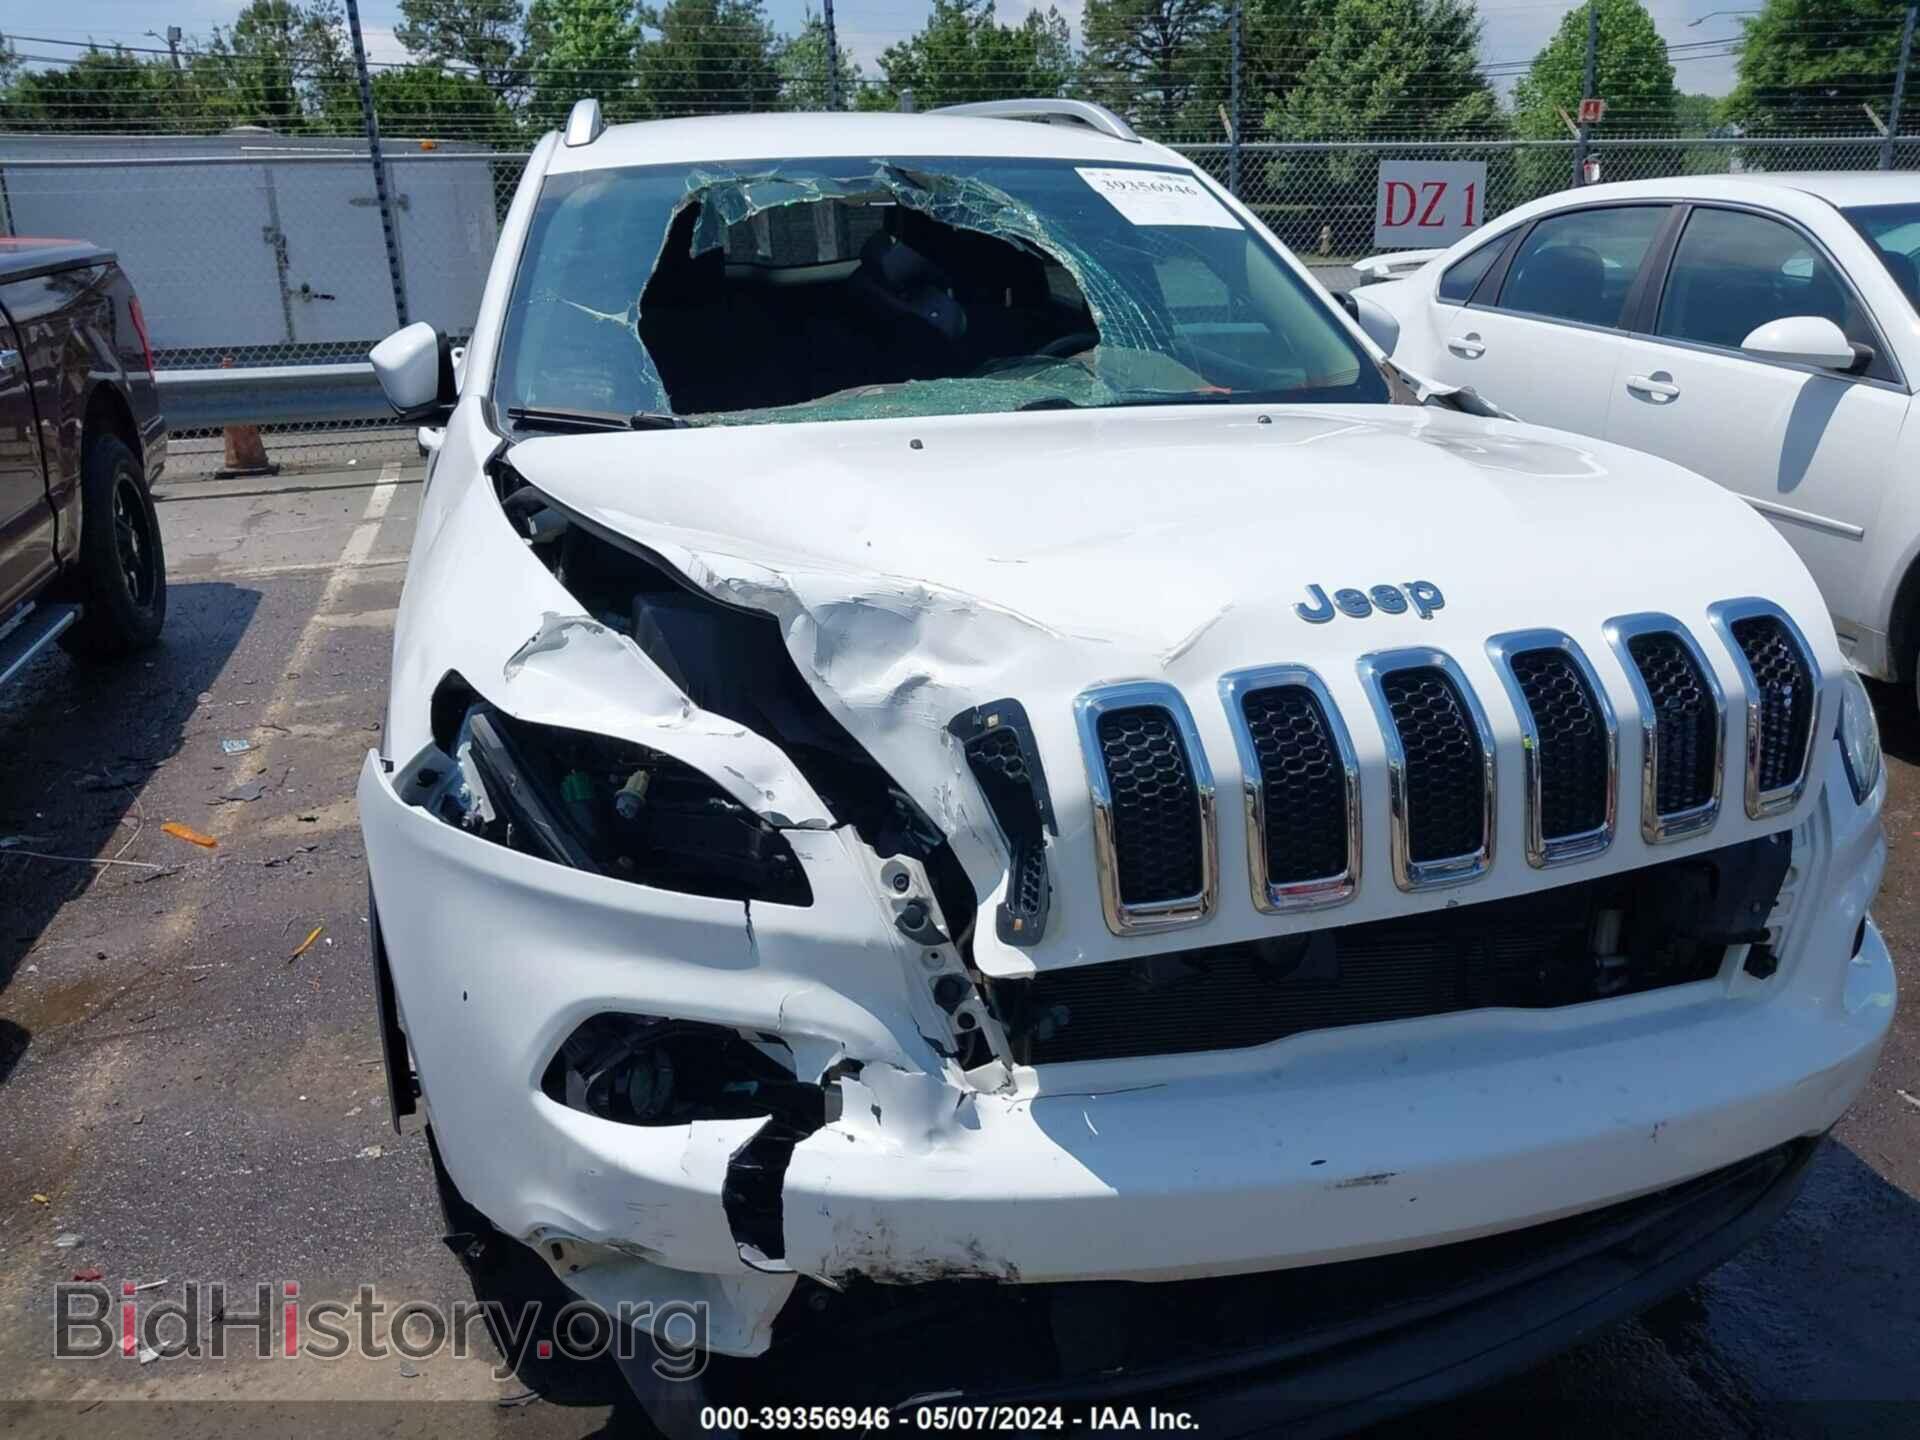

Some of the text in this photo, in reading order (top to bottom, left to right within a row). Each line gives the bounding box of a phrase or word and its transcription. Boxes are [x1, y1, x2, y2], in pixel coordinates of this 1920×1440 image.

[1101, 179, 1199, 196] 39356946
[1382, 182, 1477, 227] DZ 1
[1294, 580, 1445, 624] Jeep
